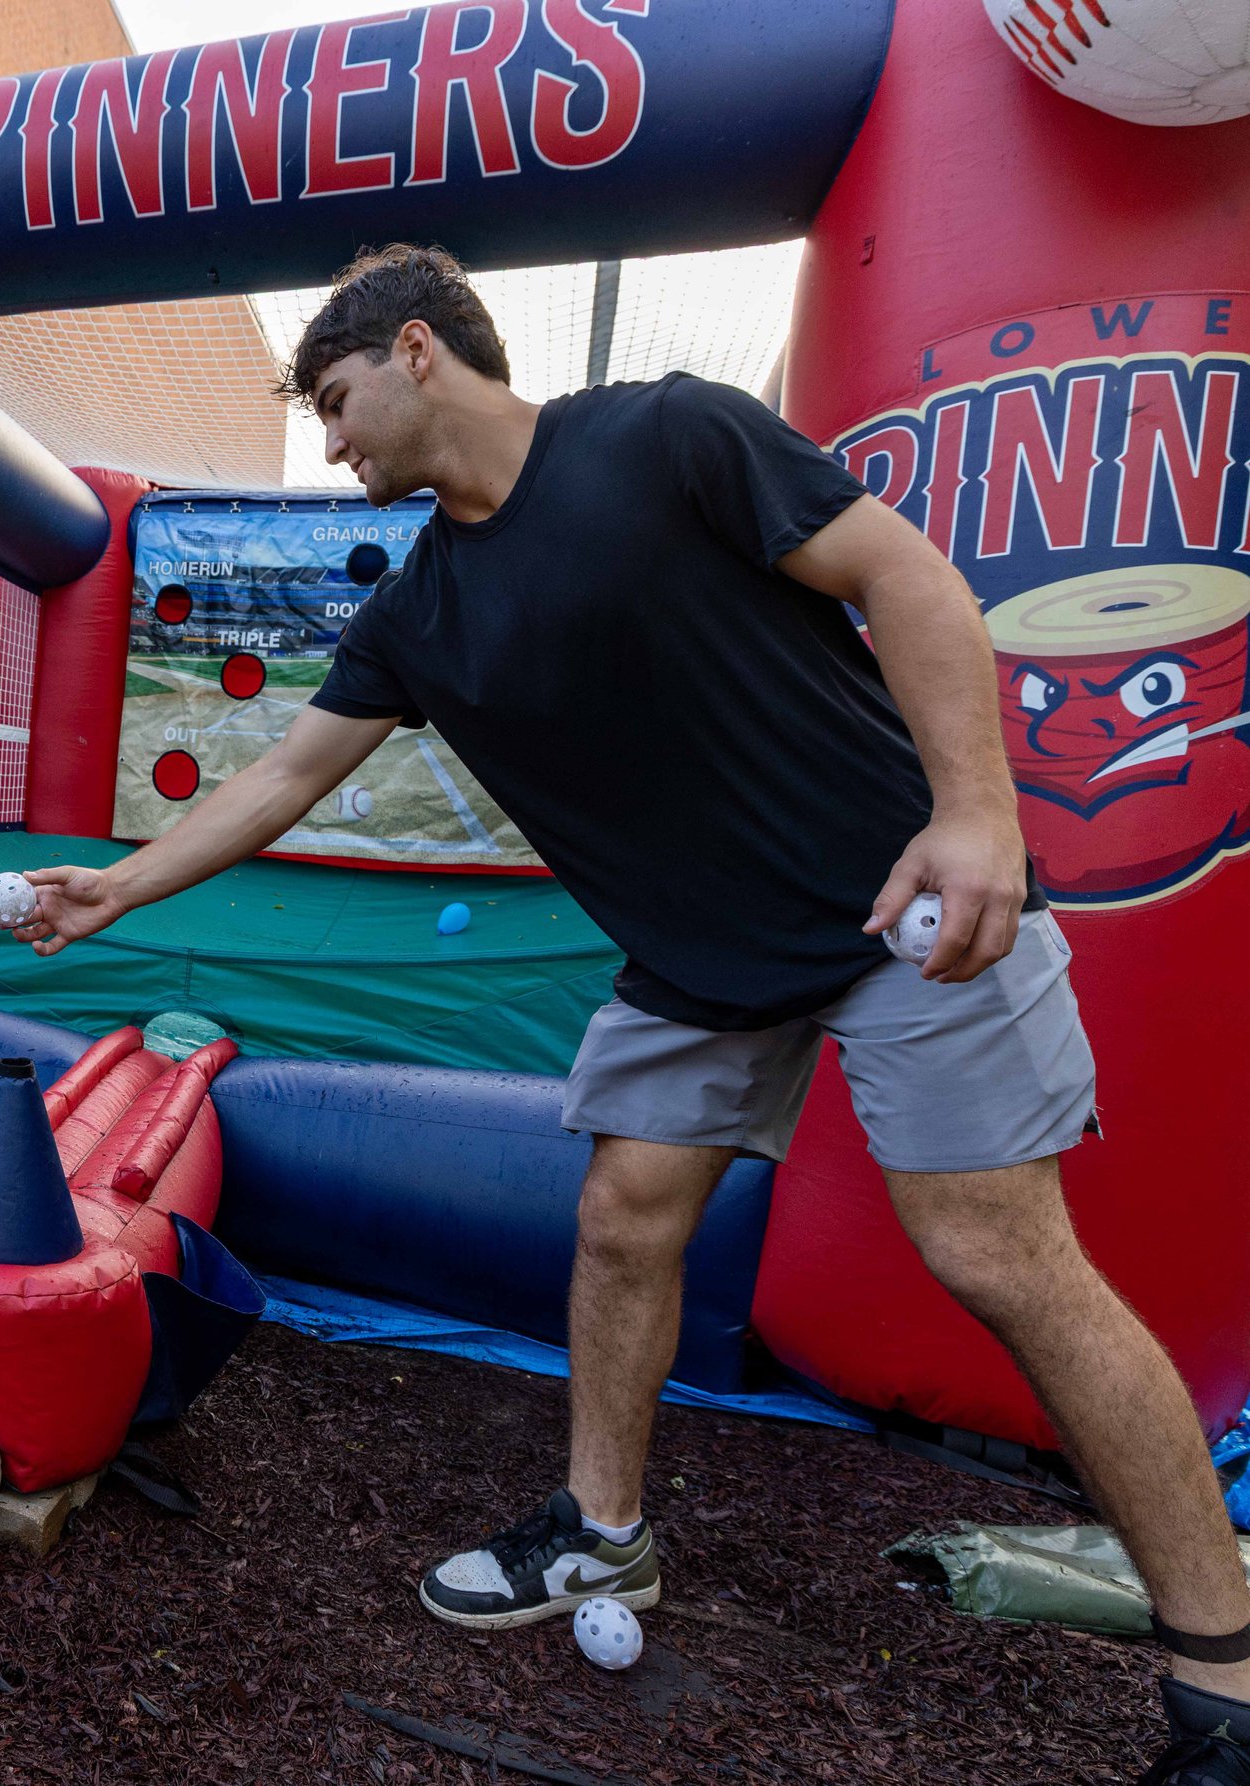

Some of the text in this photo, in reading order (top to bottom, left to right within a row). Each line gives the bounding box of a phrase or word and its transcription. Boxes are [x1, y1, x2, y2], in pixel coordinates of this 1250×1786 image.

[921, 298, 1232, 383] LOWE
[840, 370, 1250, 563] PINN
[312, 526, 420, 542] GRAND SLA
[148, 561, 235, 577] HOMERUN
[217, 630, 282, 648] TRIPLE
[164, 726, 200, 744] OUT
